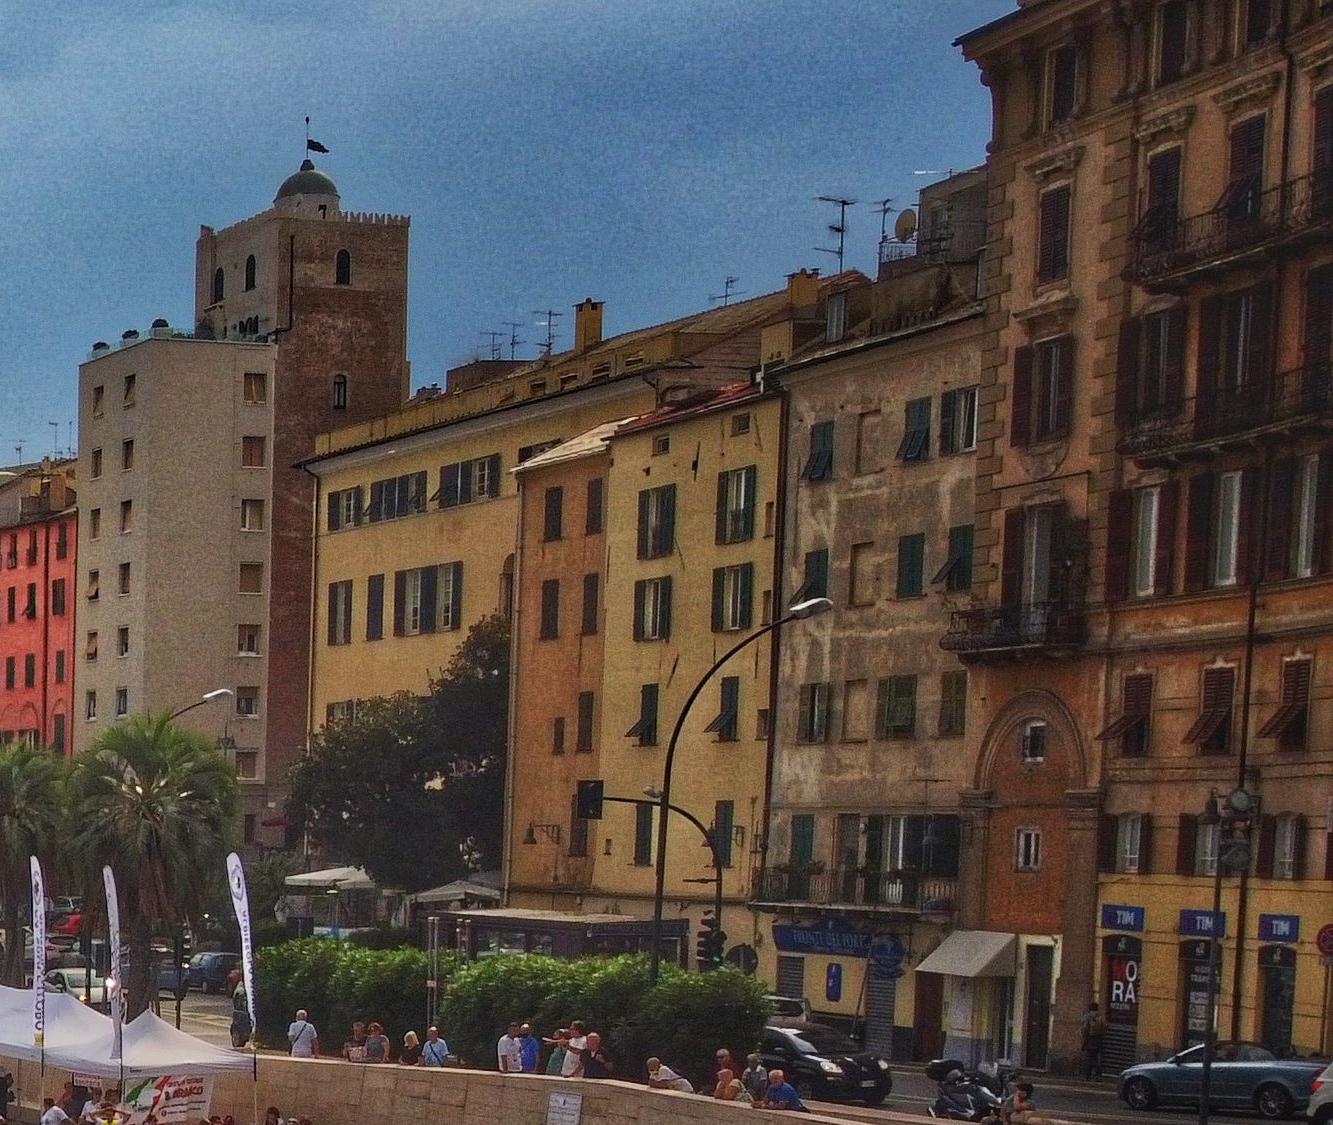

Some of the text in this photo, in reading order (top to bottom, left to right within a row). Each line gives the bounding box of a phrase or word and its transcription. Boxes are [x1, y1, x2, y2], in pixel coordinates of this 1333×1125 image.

[1116, 910, 1134, 925] TIM
[1196, 916, 1213, 930] TIM
[1272, 920, 1290, 935] TIM
[1111, 980, 1136, 1003] RA
